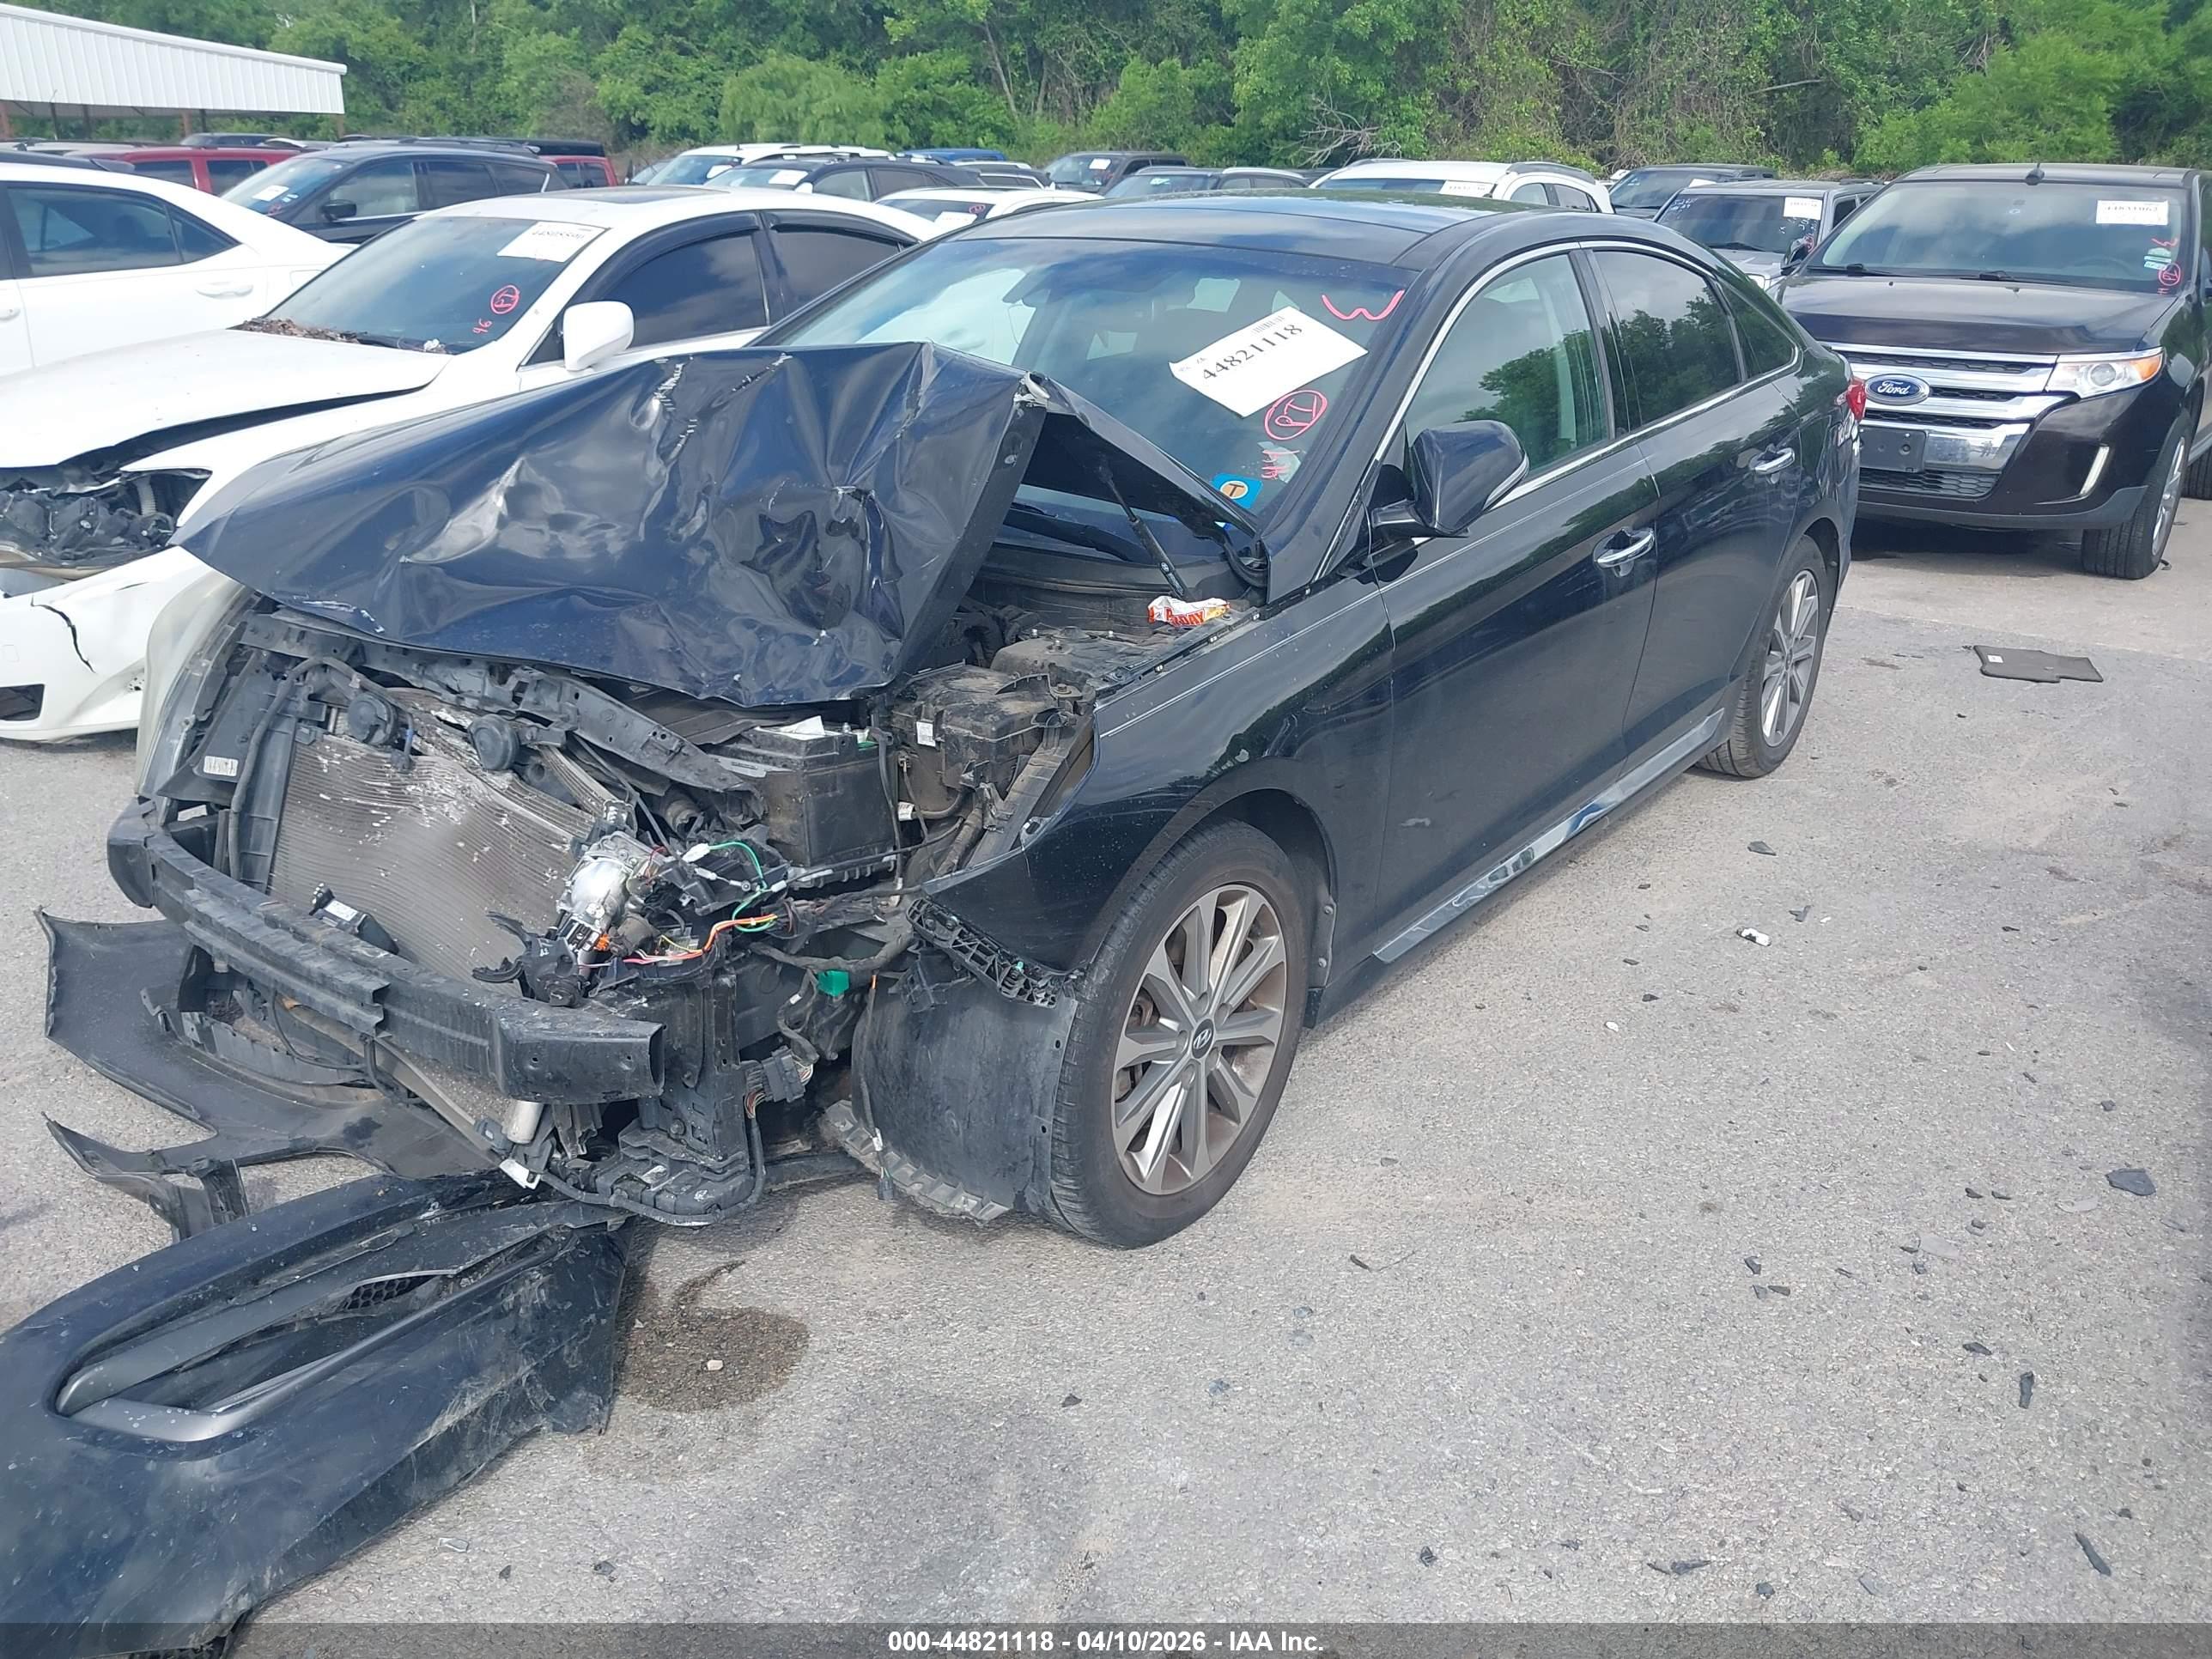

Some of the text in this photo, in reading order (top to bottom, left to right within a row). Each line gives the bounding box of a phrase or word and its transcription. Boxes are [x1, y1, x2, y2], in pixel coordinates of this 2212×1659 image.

[1202, 324, 1303, 380] 44821118
[1877, 380, 1911, 395] Ford
[1227, 483, 1246, 497] T
